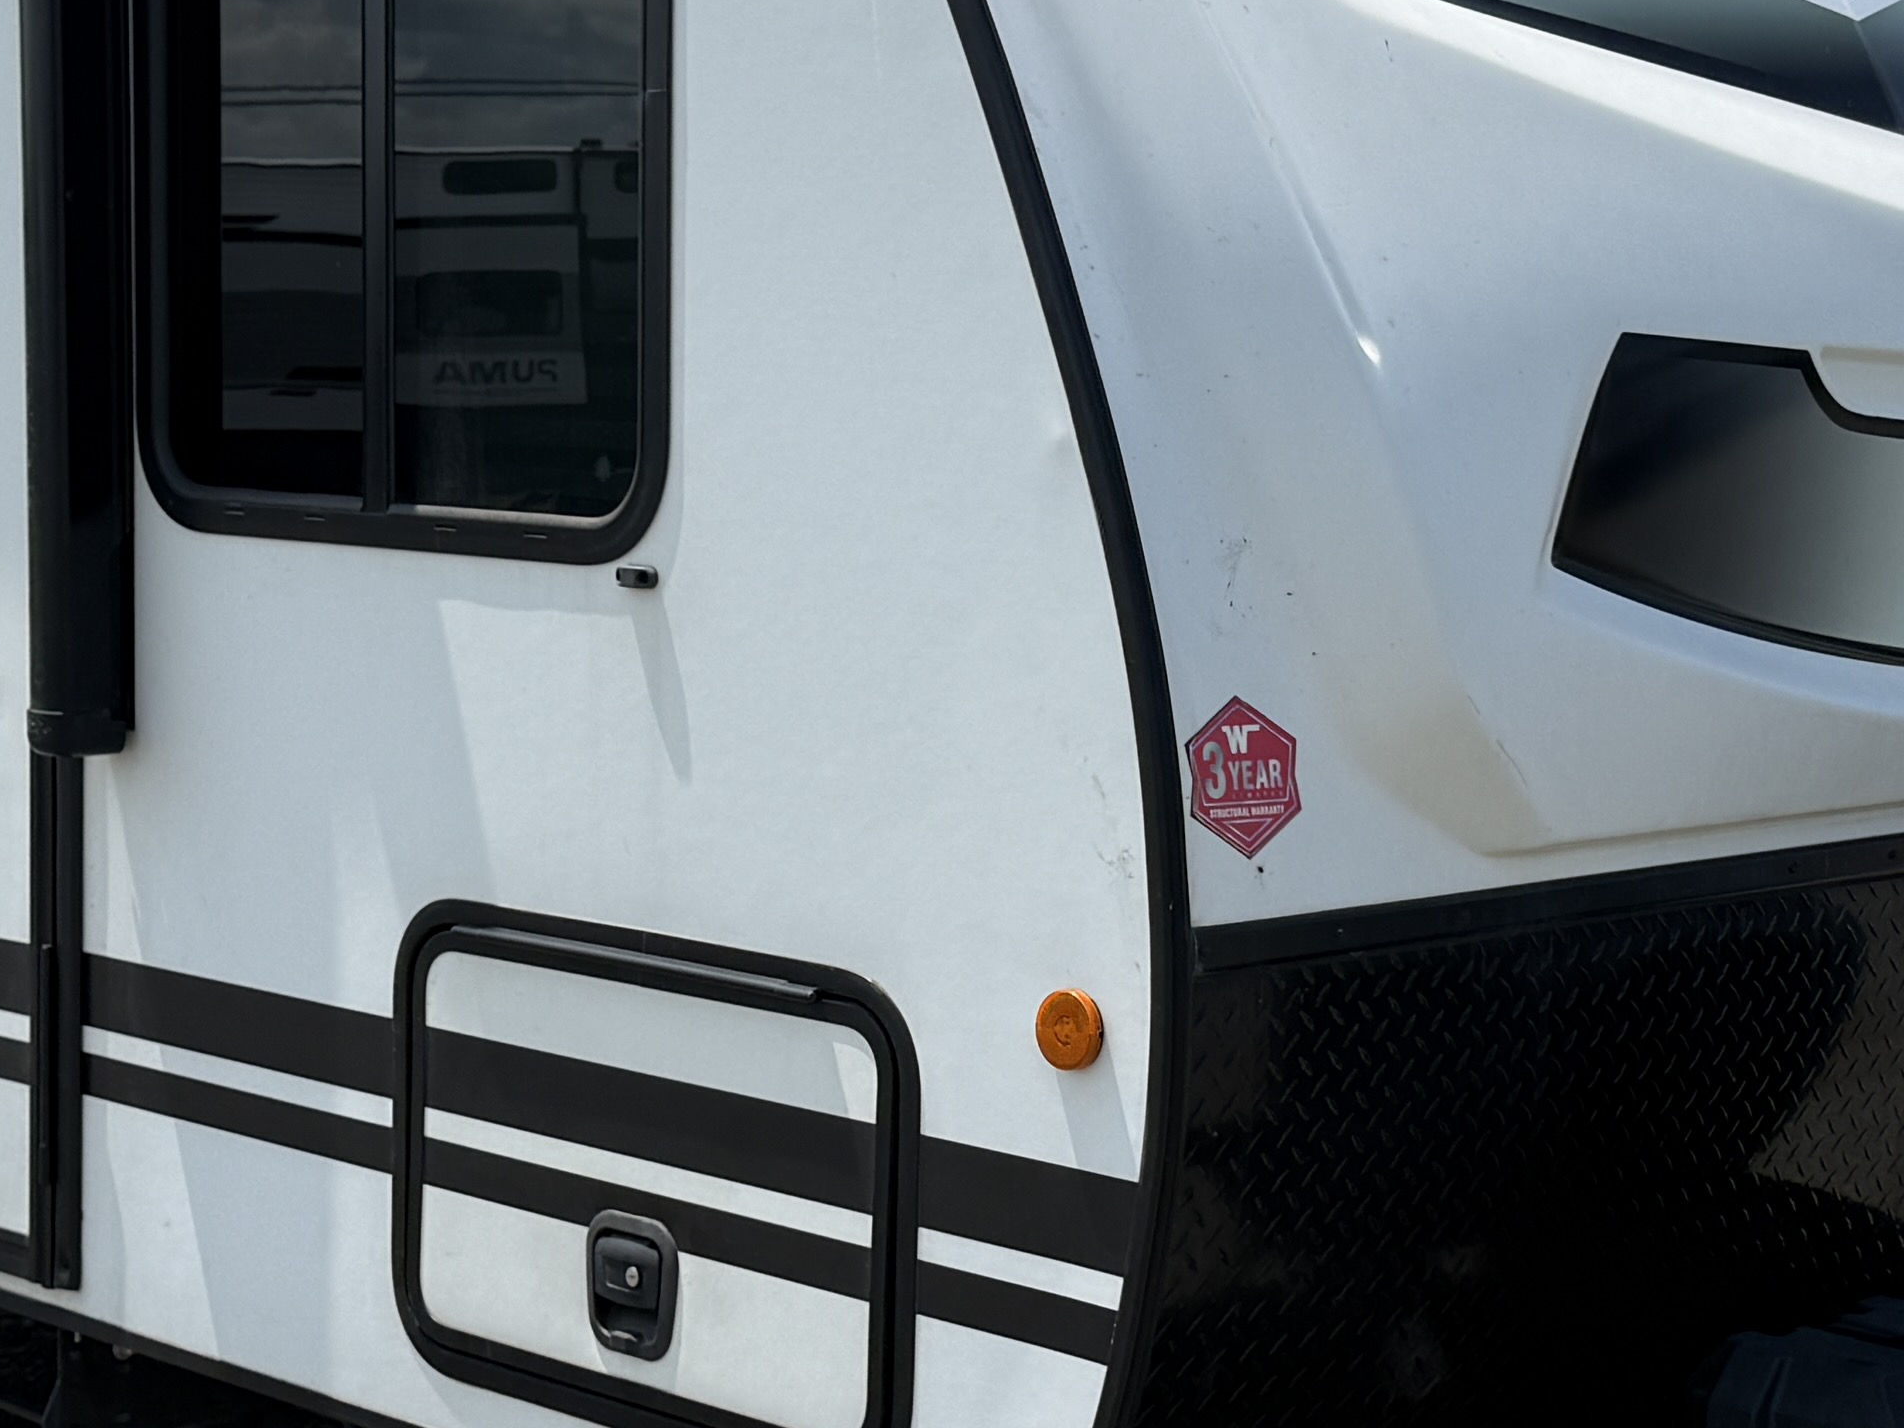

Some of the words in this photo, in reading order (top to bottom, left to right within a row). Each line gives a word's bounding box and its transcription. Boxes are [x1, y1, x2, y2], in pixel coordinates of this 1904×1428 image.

[1202, 741, 1227, 799] 3
[1228, 759, 1282, 790] YEAR
[1251, 804, 1284, 816] WARRANTY
